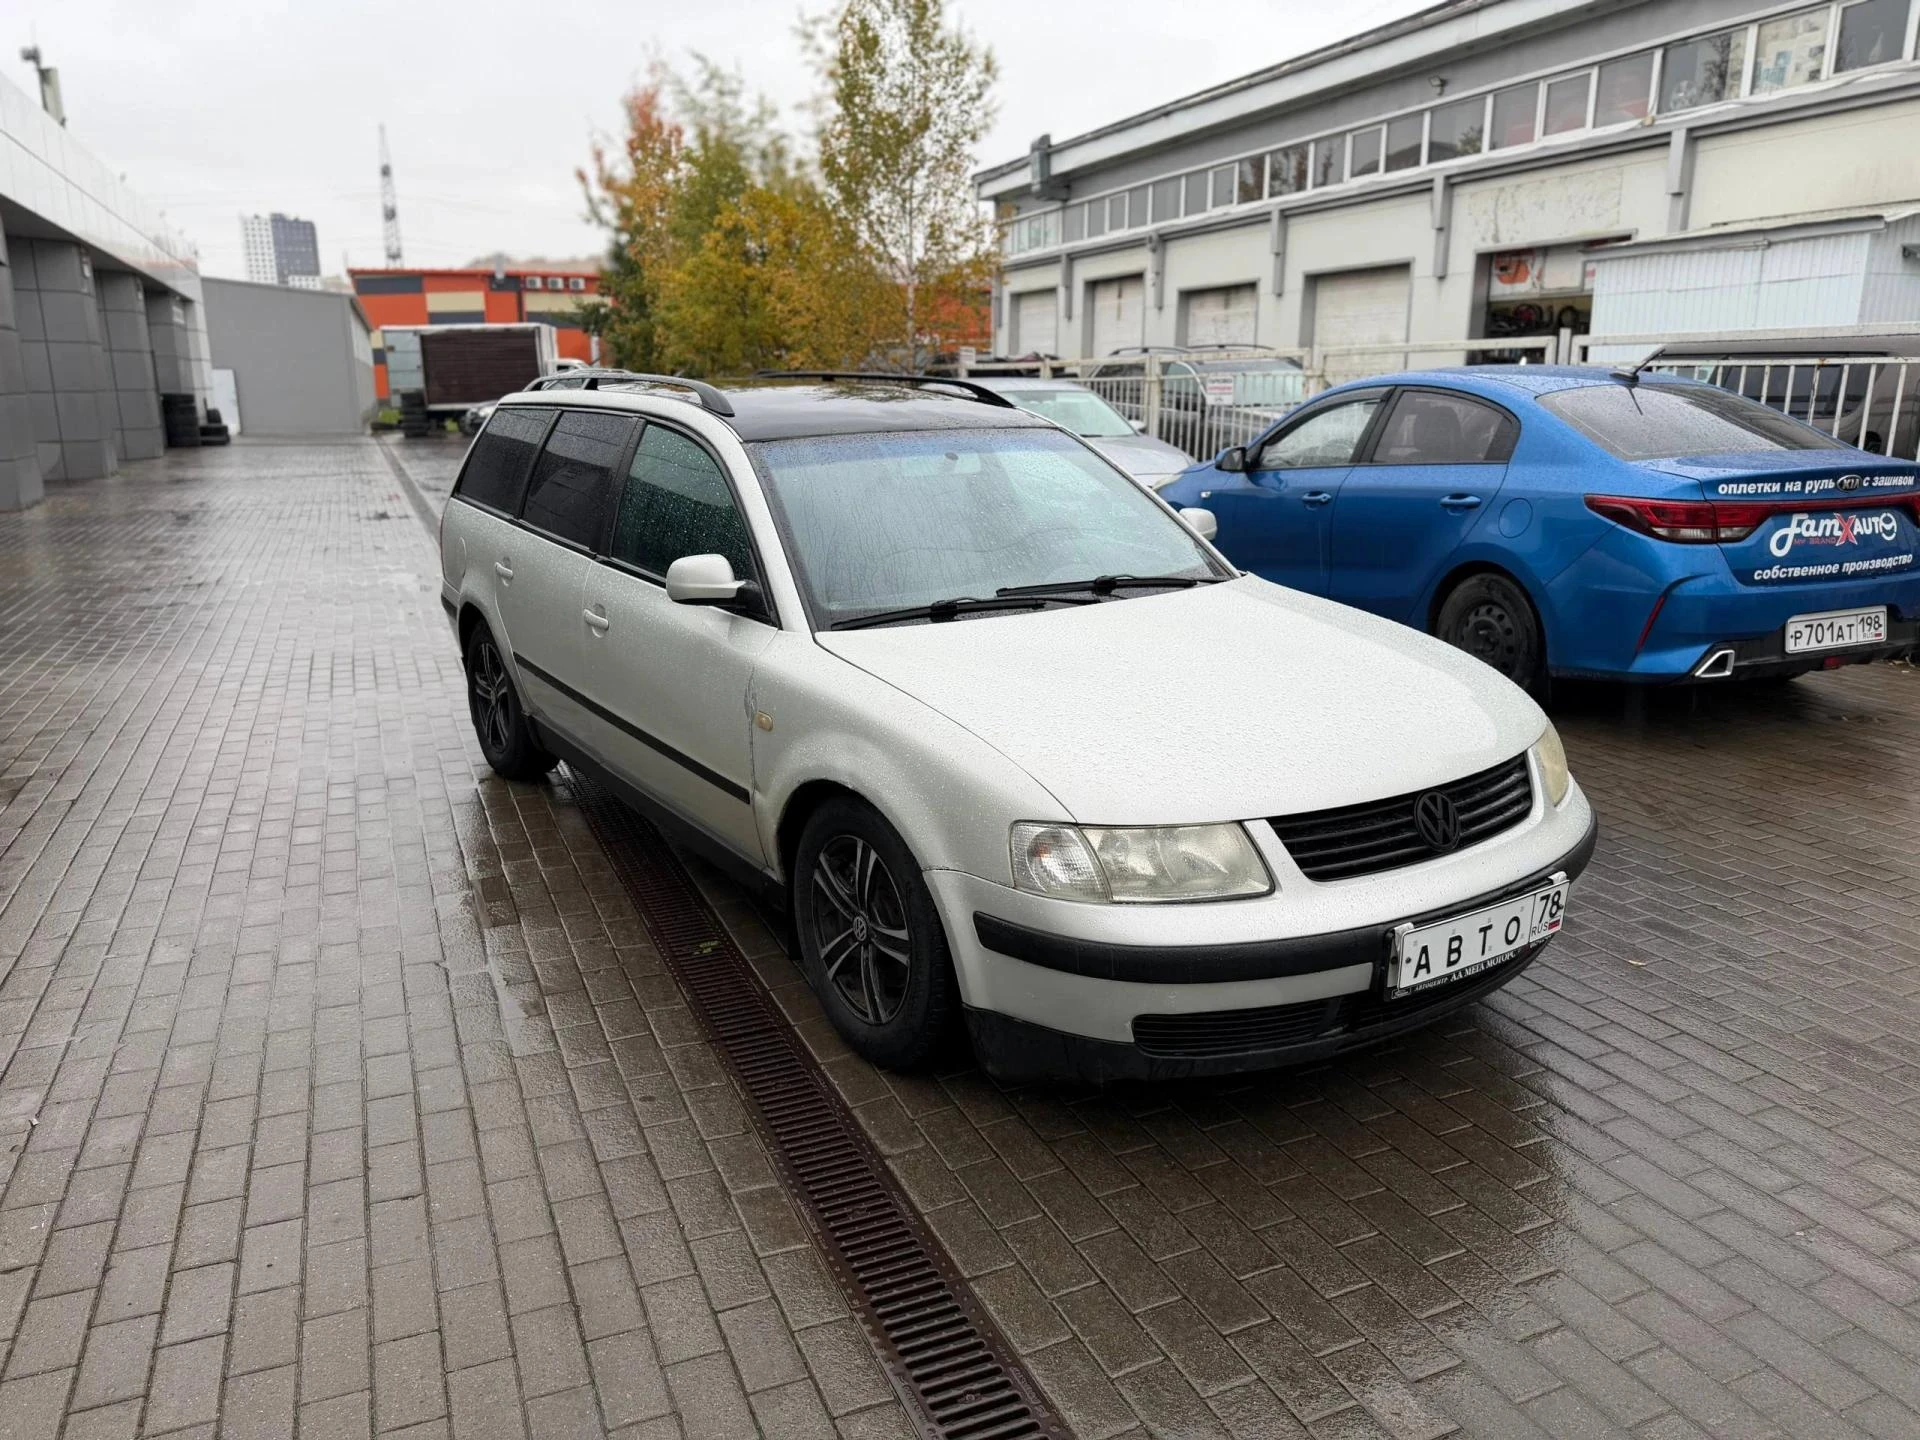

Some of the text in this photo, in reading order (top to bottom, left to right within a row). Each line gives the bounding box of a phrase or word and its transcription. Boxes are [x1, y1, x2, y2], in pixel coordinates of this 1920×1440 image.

[1718, 475, 1915, 495] оплетки на руль с зашивом
[1809, 537, 1837, 545] BRAND
[1754, 553, 1913, 580] собственное производство
[1858, 615, 1880, 633] 198
[1539, 890, 1562, 923] 78
[1531, 920, 1549, 936] RUS
